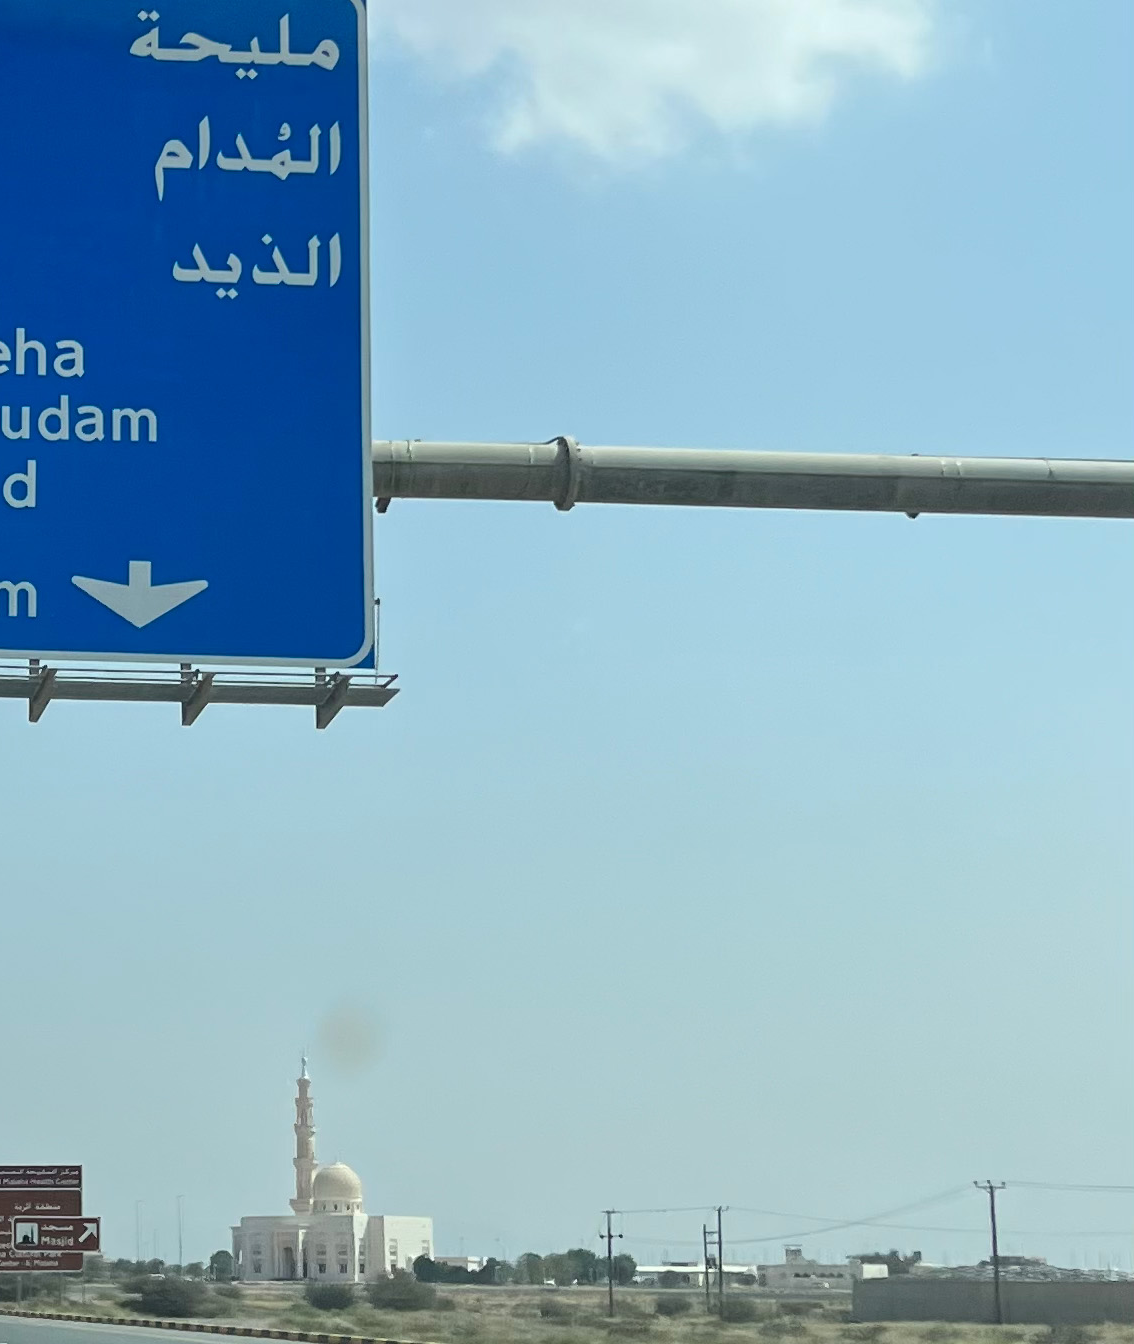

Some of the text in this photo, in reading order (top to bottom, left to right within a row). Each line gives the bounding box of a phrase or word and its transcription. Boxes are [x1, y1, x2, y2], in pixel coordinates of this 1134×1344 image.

[129, 10, 340, 80] مليحة
[172, 232, 342, 300] الذيد
[40, 1235, 74, 1247] Masjid
